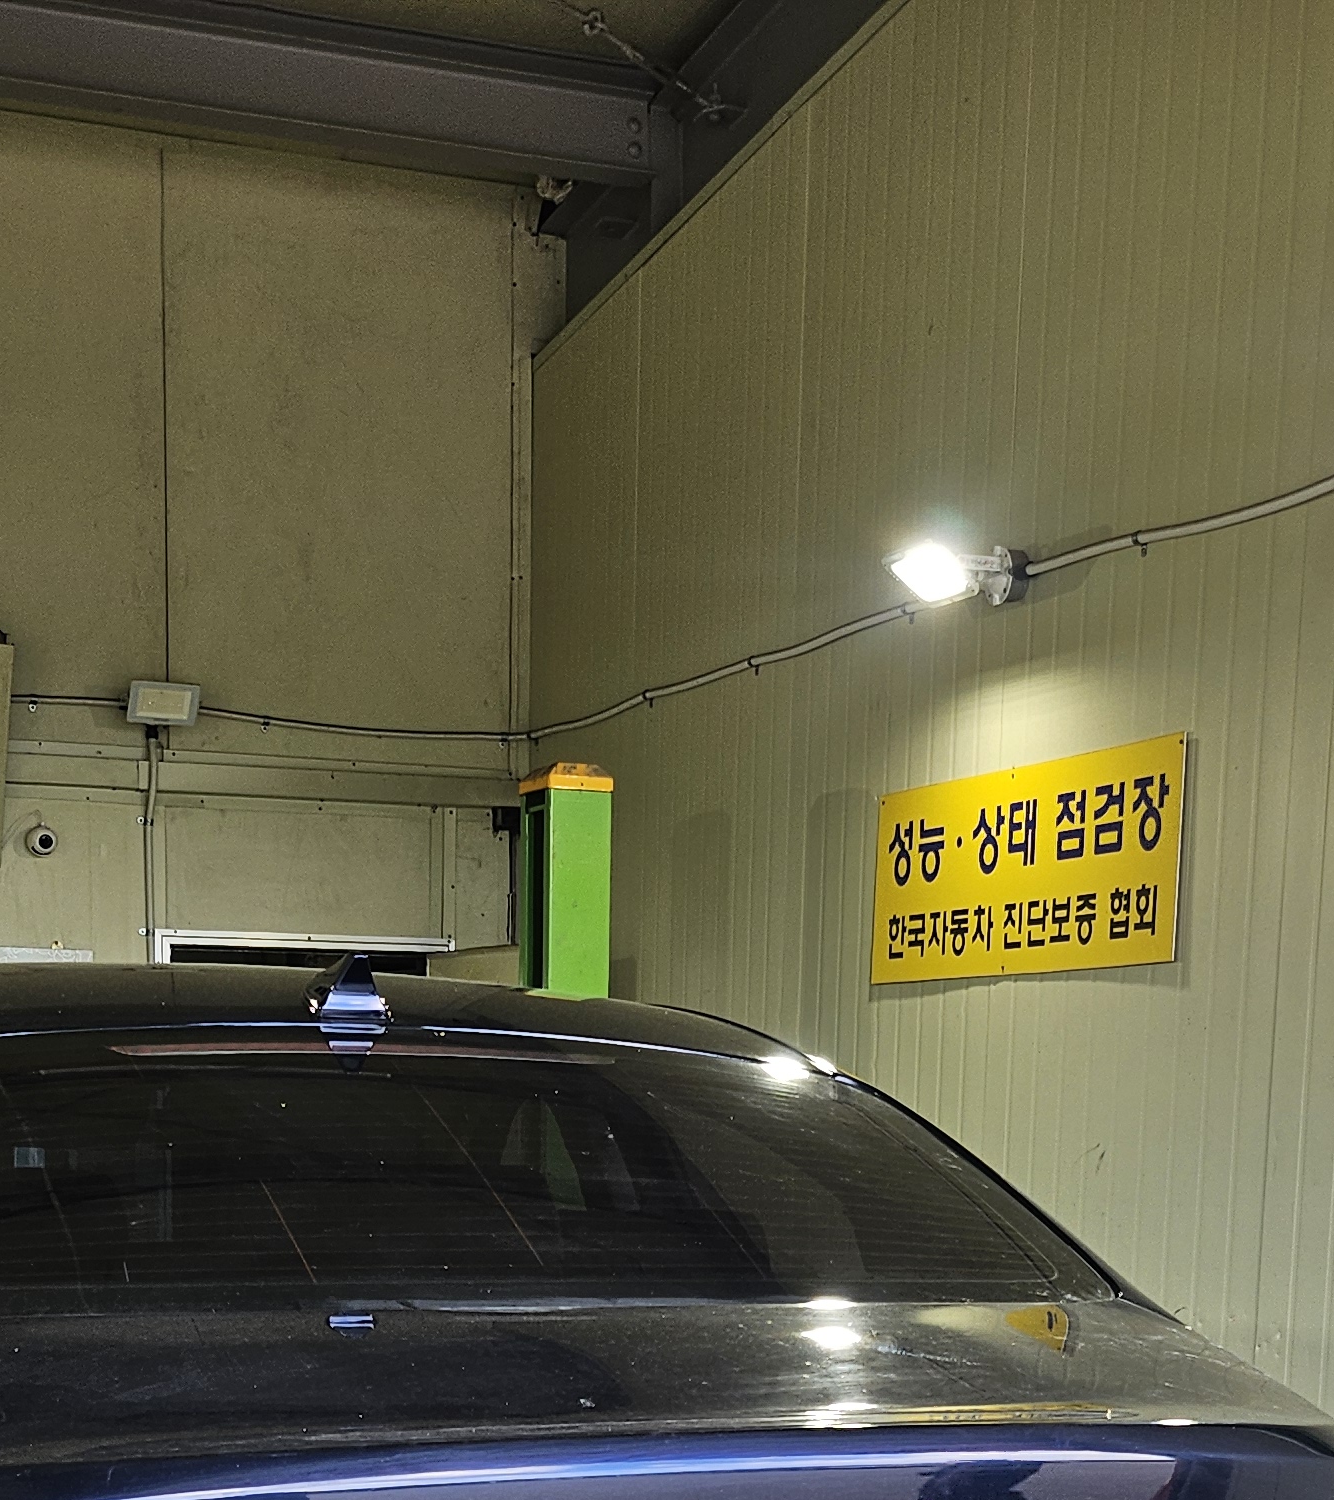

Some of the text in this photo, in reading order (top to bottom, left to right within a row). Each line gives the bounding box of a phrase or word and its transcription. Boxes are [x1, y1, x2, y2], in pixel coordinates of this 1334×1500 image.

[1055, 773, 1171, 863] 점검장
[887, 883, 1159, 960] 한국자동차 진단보증 협회
